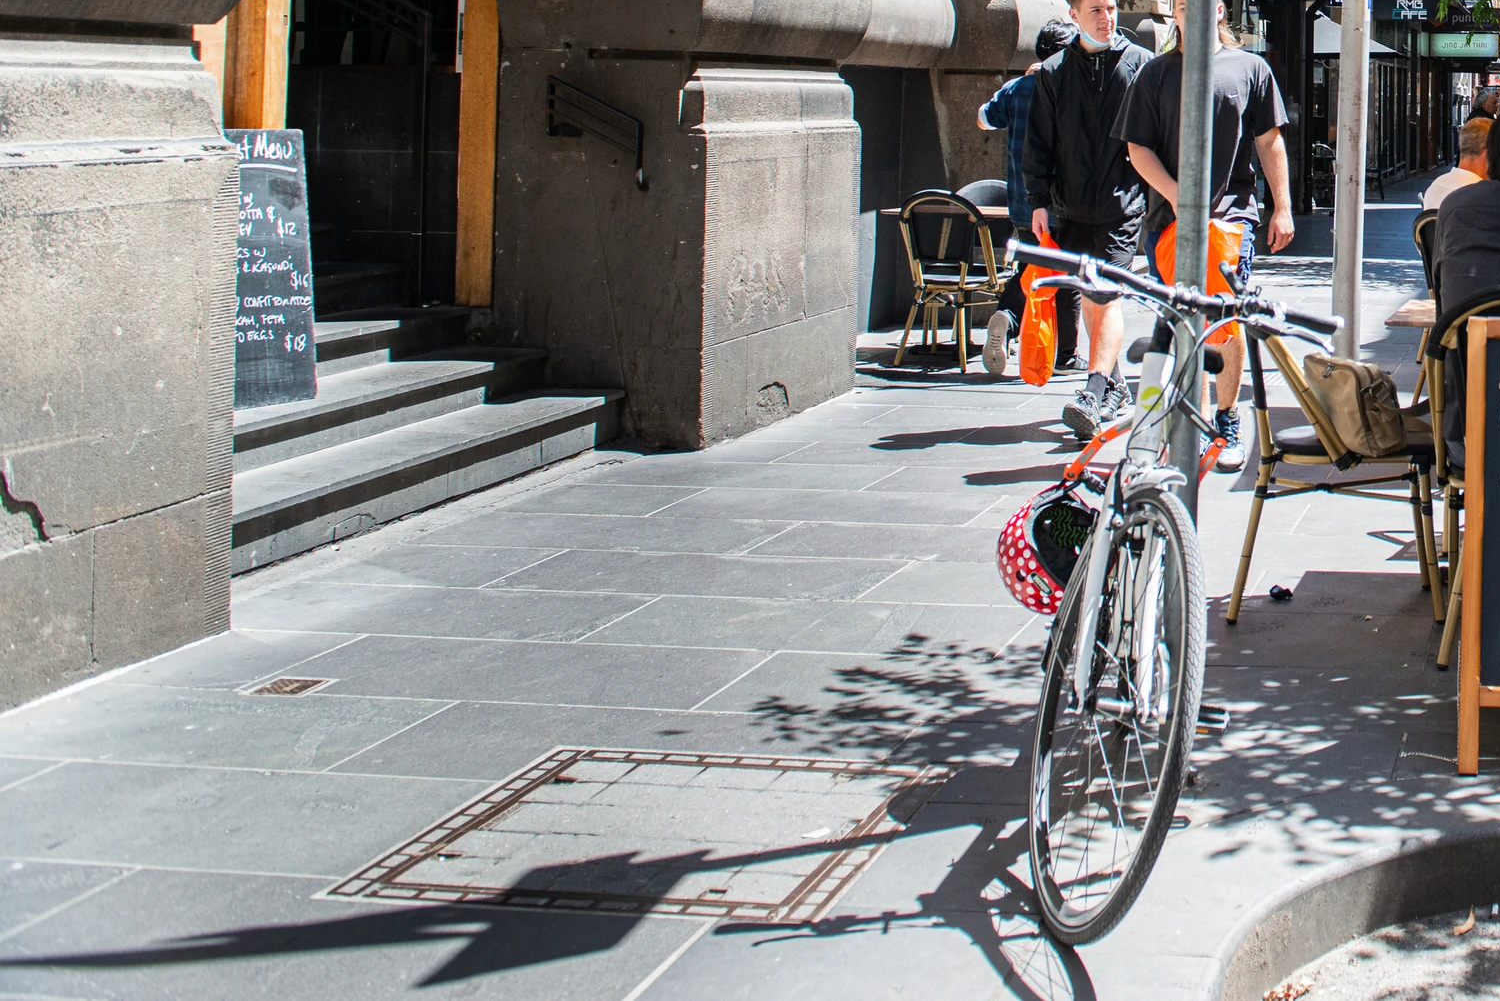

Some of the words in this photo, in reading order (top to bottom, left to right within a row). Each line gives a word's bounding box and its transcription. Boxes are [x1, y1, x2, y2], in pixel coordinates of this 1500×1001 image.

[1392, 10, 1428, 20] CAFE
[1396, 0, 1423, 10] RMB
[253, 132, 293, 160] Menu
[276, 217, 297, 239] $12
[289, 270, 310, 290] $16
[261, 313, 286, 325] FETA
[284, 332, 307, 352] $18
